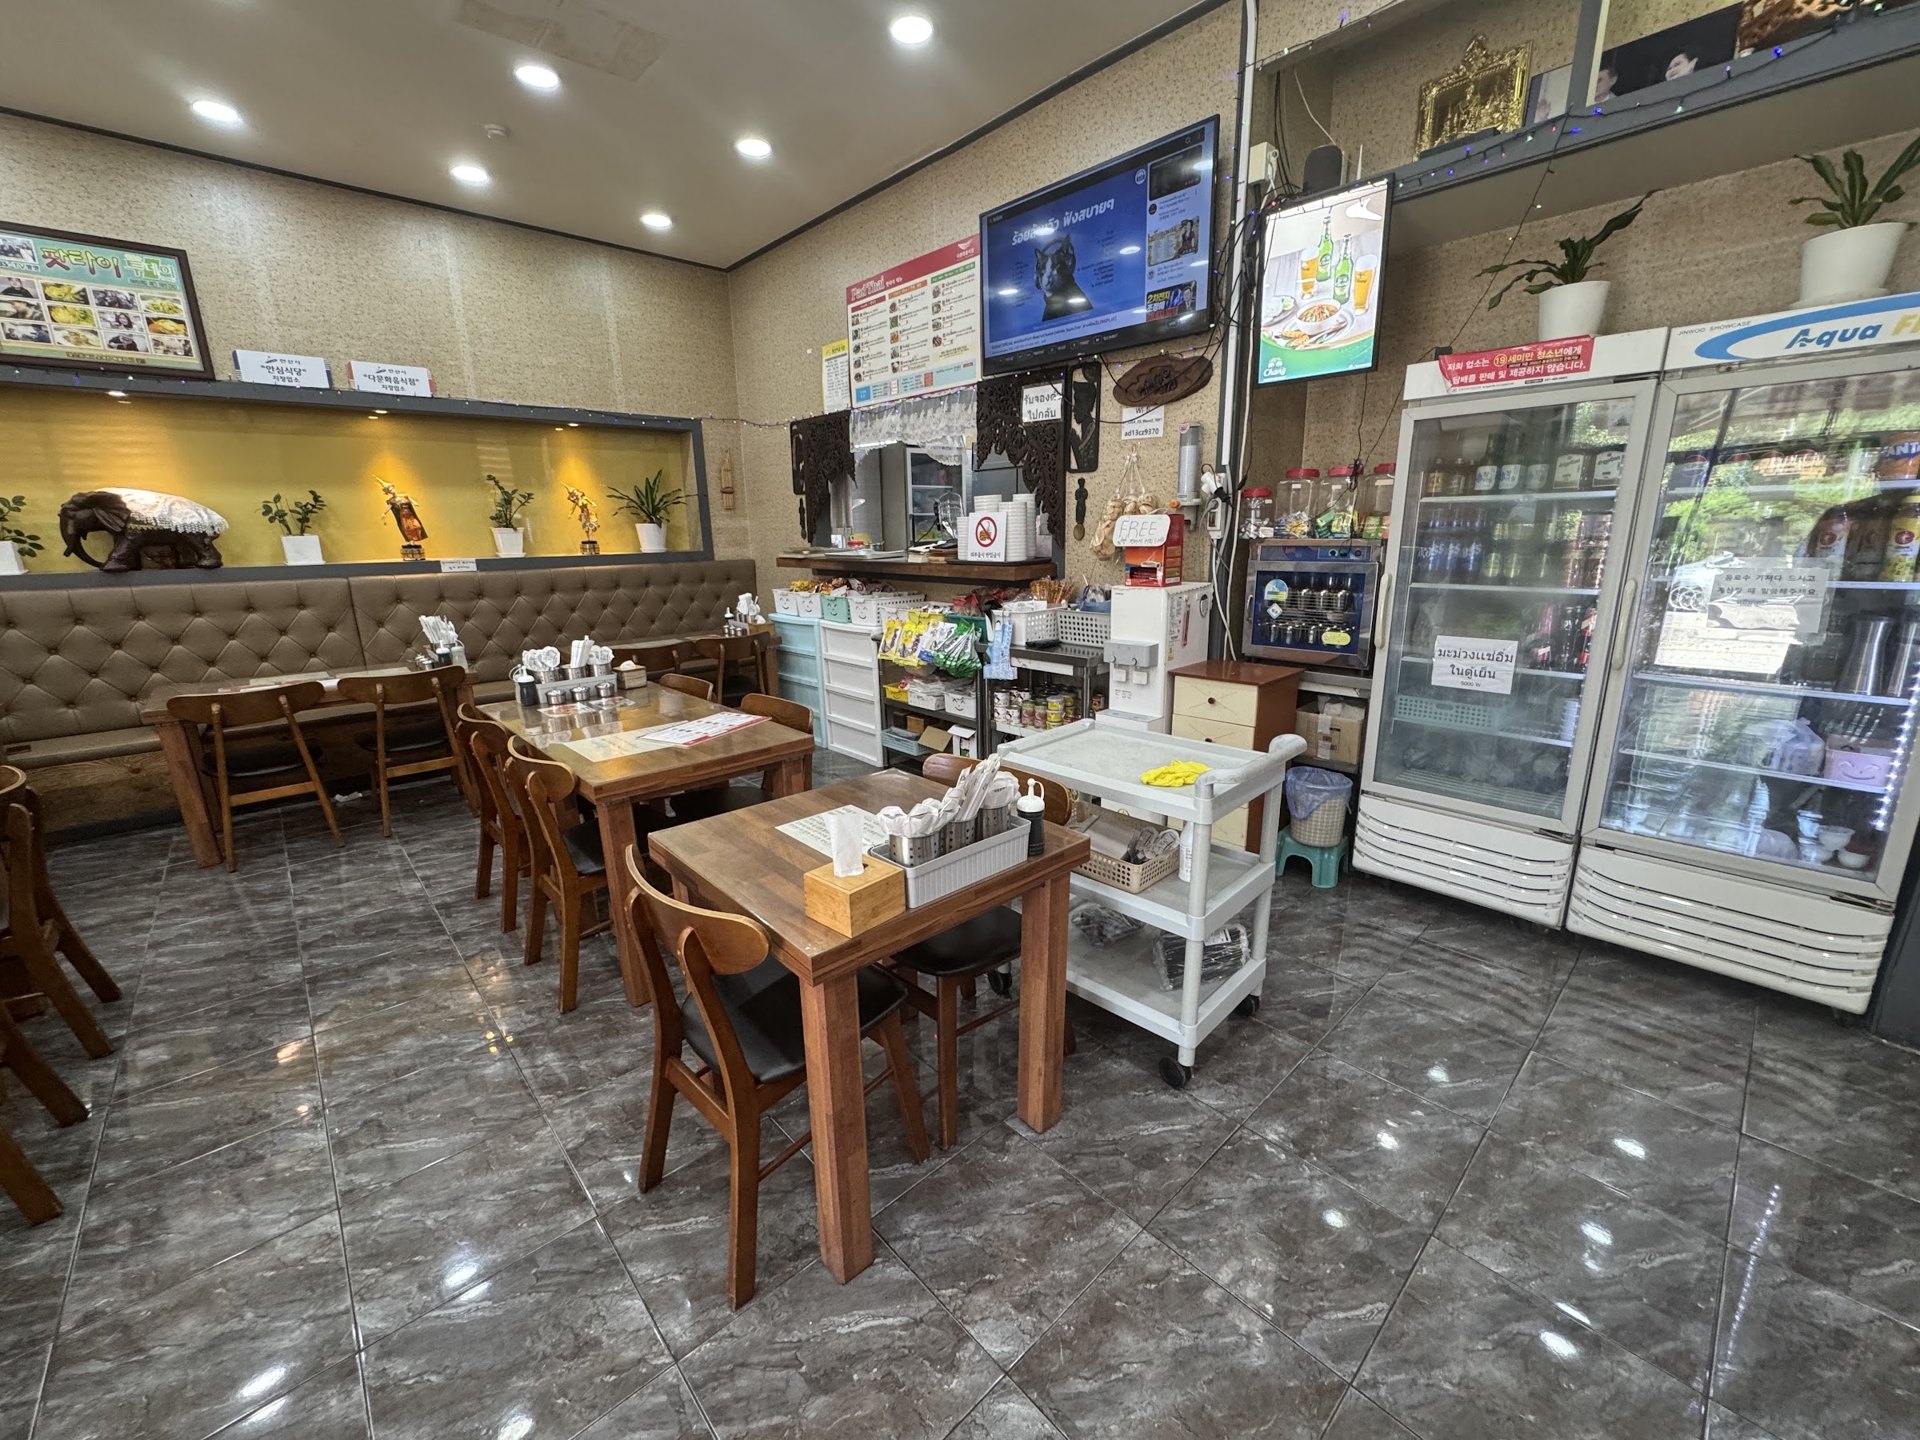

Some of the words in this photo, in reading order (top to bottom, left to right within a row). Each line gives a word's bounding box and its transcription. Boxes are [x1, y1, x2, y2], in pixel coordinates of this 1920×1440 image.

[41, 247, 122, 279] 팟타이
[1678, 327, 1706, 336] JINWOO
[1709, 320, 1751, 332] SHOWCASE
[1785, 324, 1883, 349] Aqua
[1466, 358, 1490, 369] 업소는
[1536, 345, 1582, 360] 청소년에게
[273, 375, 300, 383] 지정업소
[1479, 371, 1496, 381] 판매
[1498, 370, 1507, 380] 및
[1509, 364, 1544, 377] 제공하지
[1547, 360, 1586, 373] 않습니다.
[1026, 407, 1057, 420] ไปกลับ
[1118, 520, 1158, 539] FREE
[1437, 647, 1514, 664] มะม่วงแช่อิ่ม
[1450, 663, 1496, 680] ในตู้เย็น
